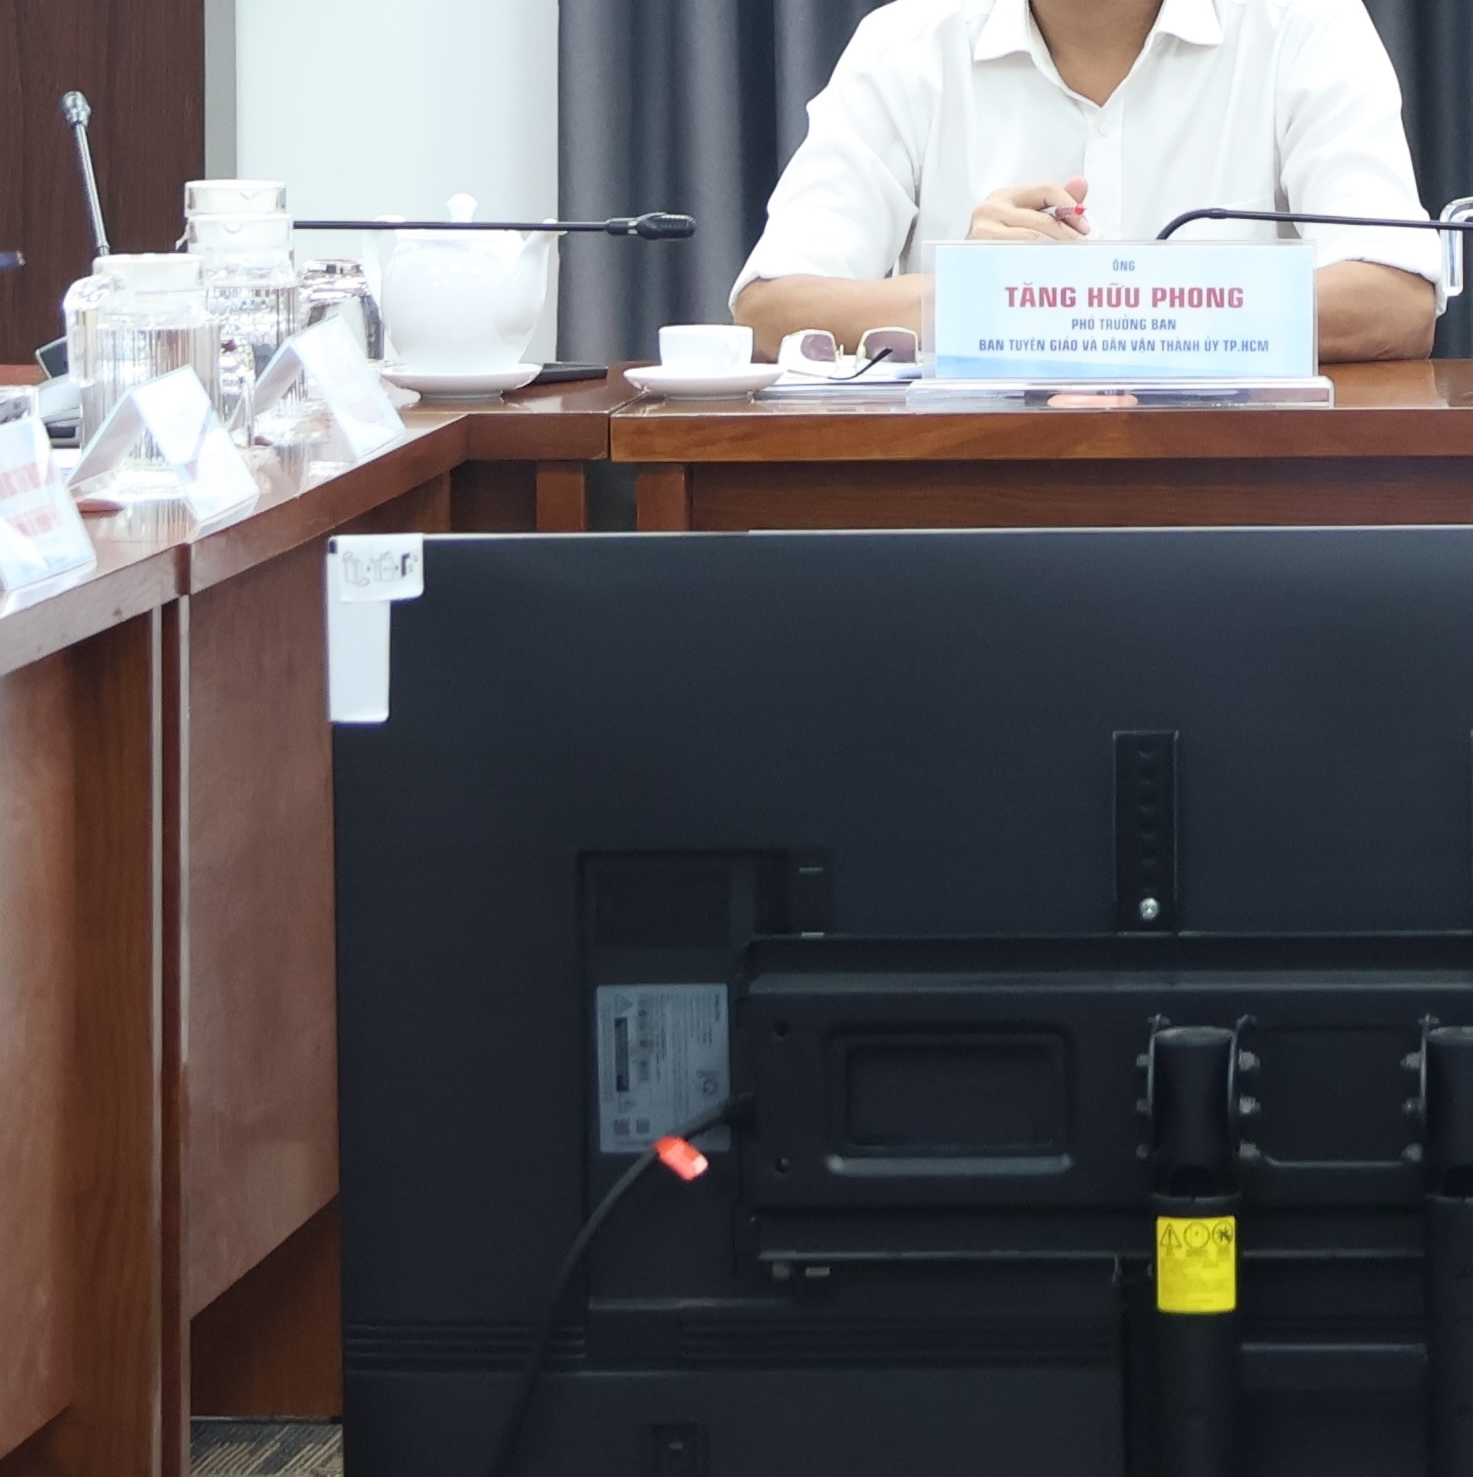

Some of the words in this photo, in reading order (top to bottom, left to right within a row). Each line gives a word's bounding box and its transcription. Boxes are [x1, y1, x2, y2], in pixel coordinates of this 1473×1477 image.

[1112, 258, 1136, 272] ÔNG
[1004, 281, 1077, 309] TĂNG
[1087, 282, 1140, 309] HỮU
[1151, 286, 1244, 309] PHONG
[1151, 318, 1177, 331] BAN
[978, 338, 1005, 352] BAN
[1223, 339, 1269, 353] TP.HCM
